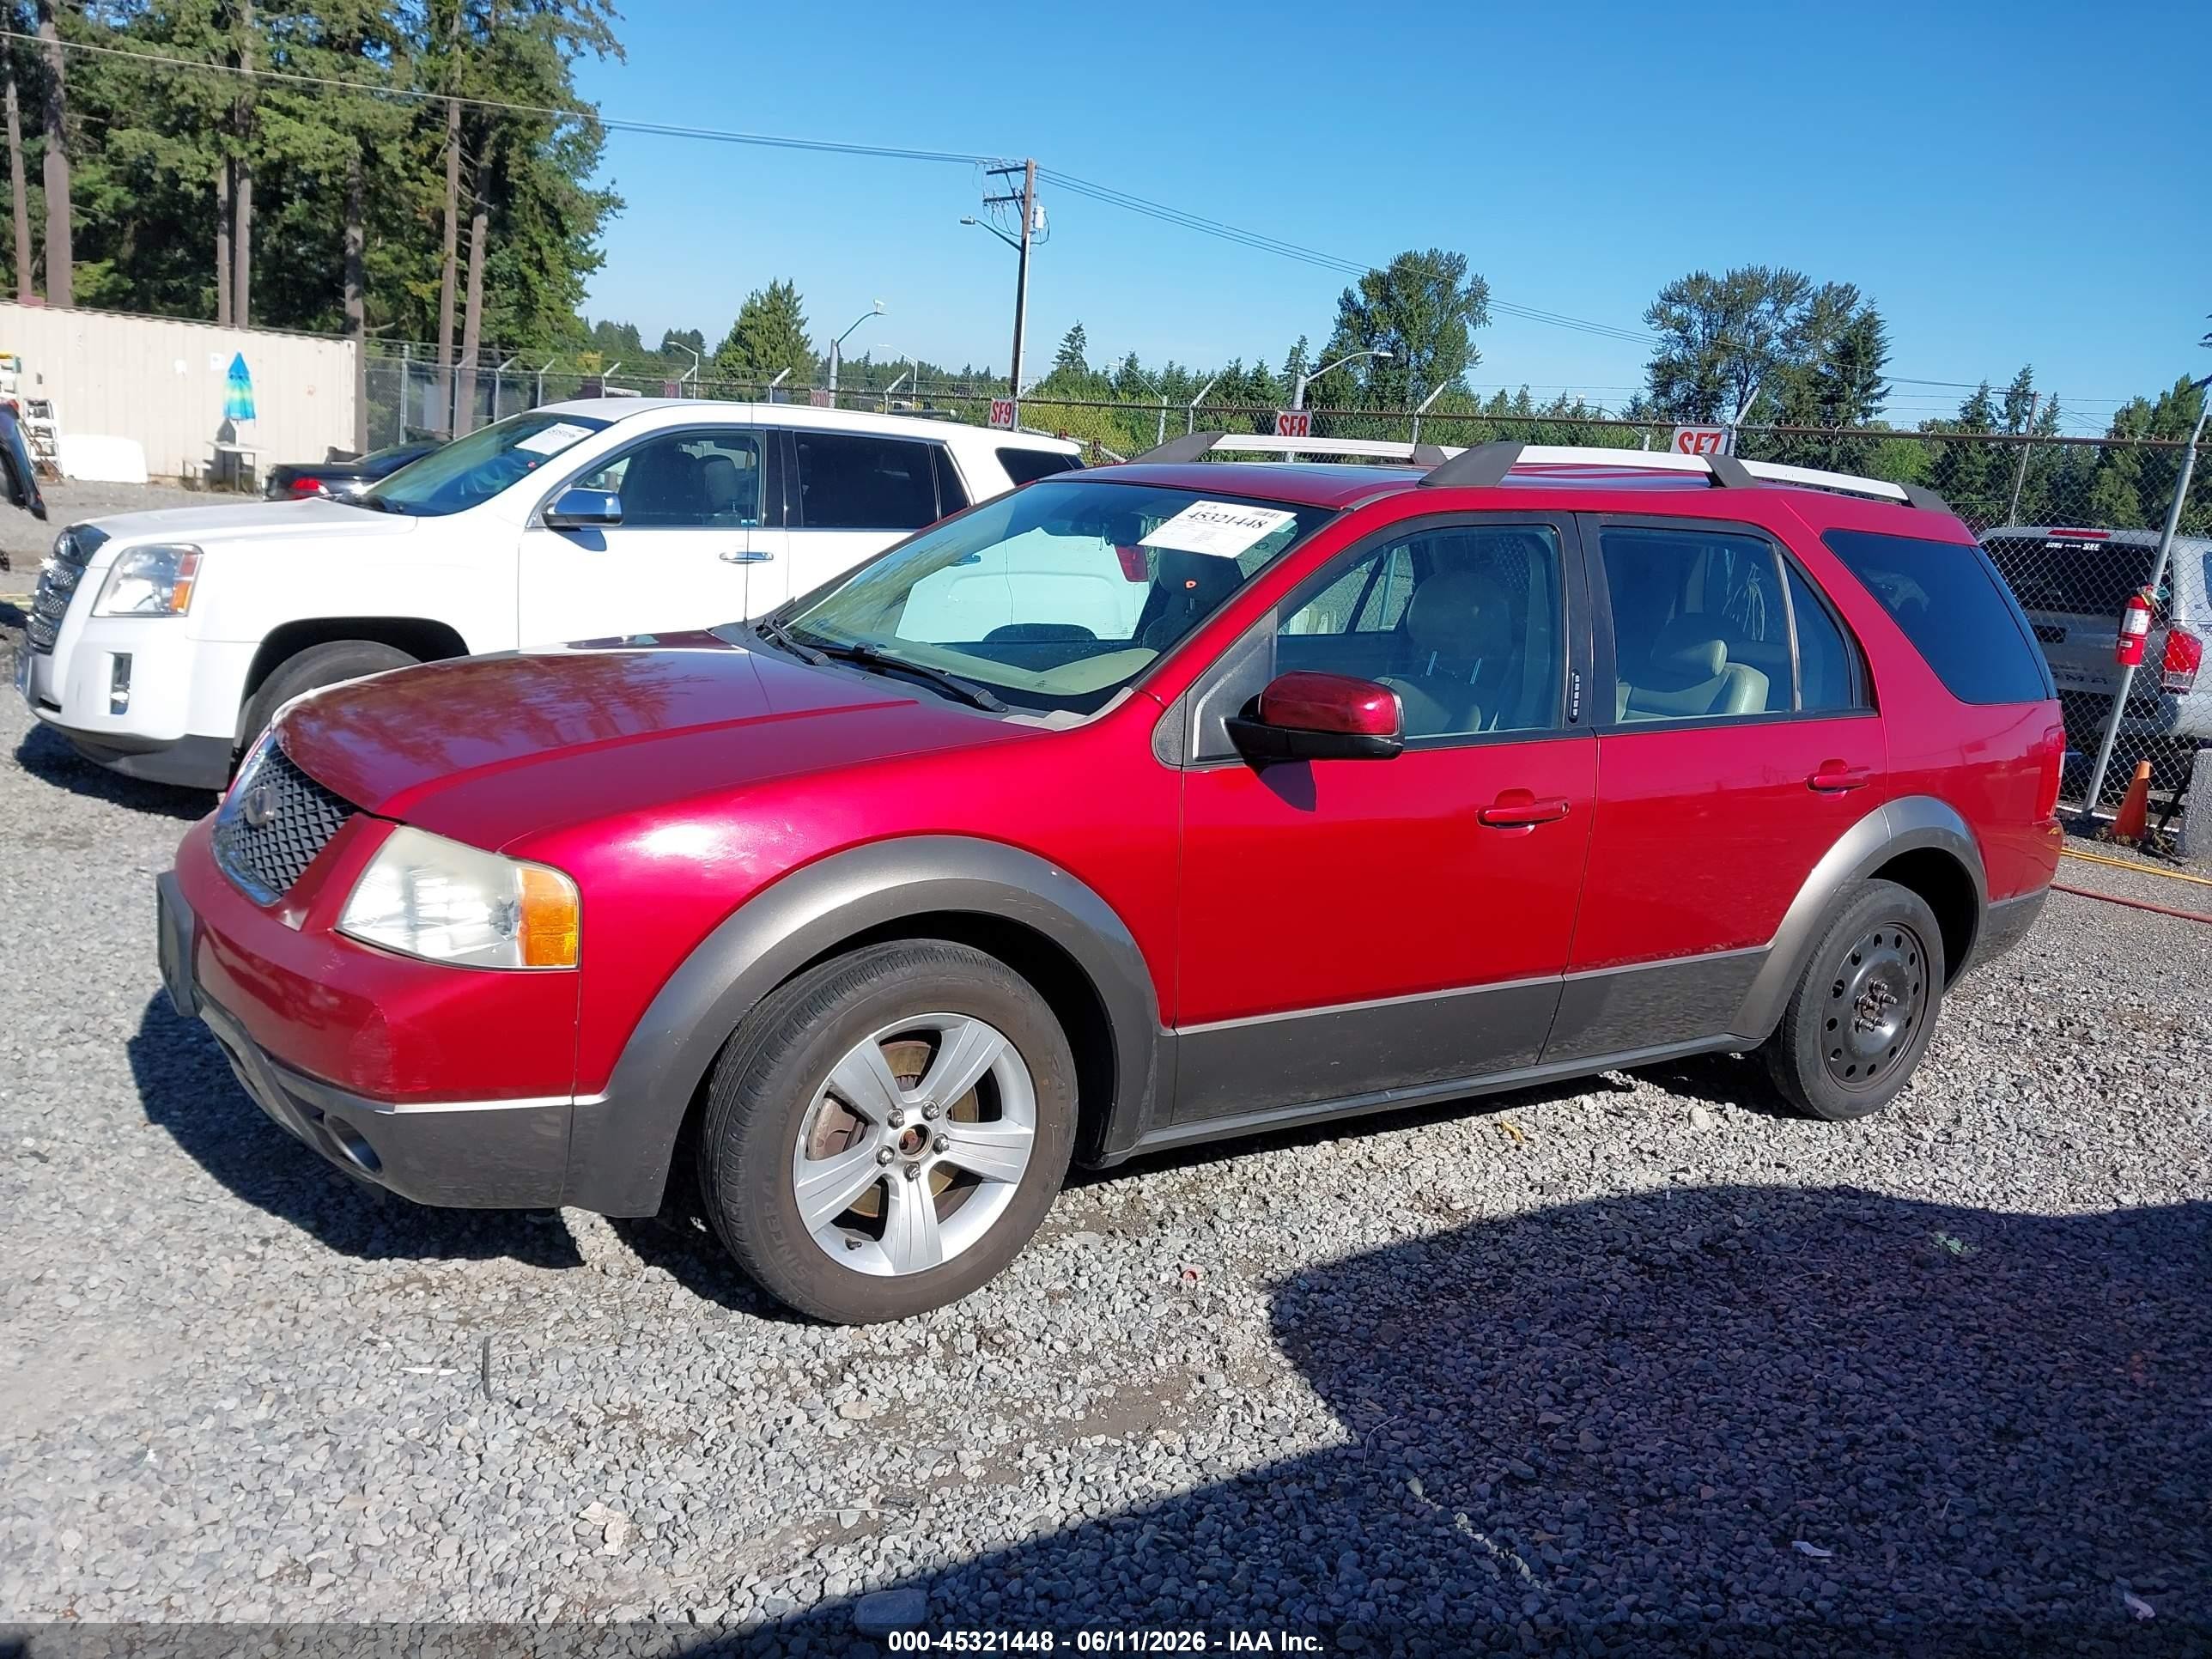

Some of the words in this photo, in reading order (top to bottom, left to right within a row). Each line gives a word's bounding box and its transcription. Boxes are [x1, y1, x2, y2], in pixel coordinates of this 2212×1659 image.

[991, 401, 1012, 424] SF9
[1278, 415, 1308, 436] SF8
[1678, 431, 1722, 455] SF7
[1188, 510, 1269, 530] 45321448
